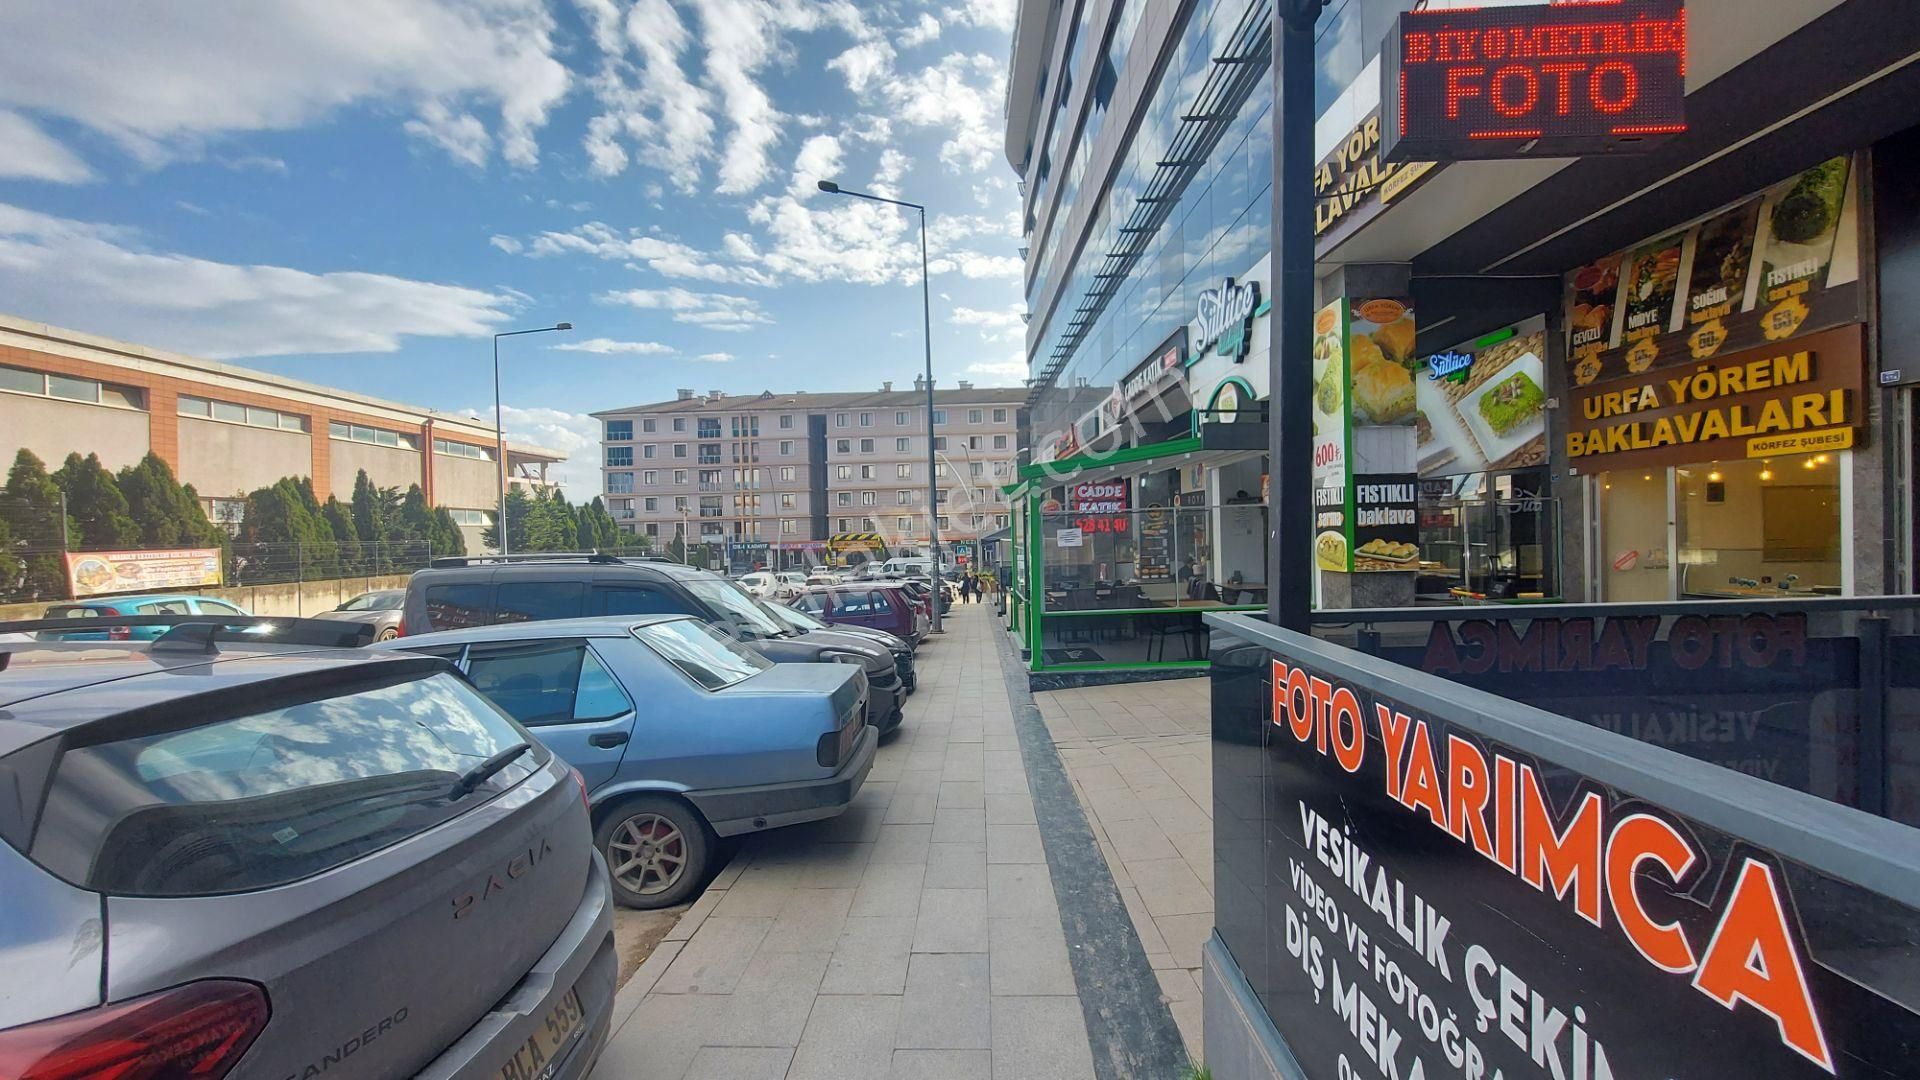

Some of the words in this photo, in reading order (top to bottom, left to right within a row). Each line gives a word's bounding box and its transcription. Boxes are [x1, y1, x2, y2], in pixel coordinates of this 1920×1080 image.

[1447, 60, 1638, 119] FOTO
[1315, 155, 1397, 235] LAVAL
[1766, 257, 1819, 287] FISTIKLI
[1196, 276, 1255, 352] Sütlüce
[1692, 287, 1728, 310] SOĞUK
[1429, 351, 1472, 381] Sütlüce
[1583, 384, 1660, 420] URFA
[1668, 351, 1809, 404] YÖREM
[1566, 388, 1845, 457] BAKLAVALARI
[1752, 437, 1797, 452] KÖRFEZ
[1800, 431, 1846, 450] ŞUBESİ
[1077, 485, 1122, 498] CADDE
[1078, 501, 1122, 514] KATIK
[1316, 486, 1344, 507] FISTIKLI
[1356, 484, 1414, 504] FISTIKLI
[1357, 507, 1416, 526] baklava
[1272, 659, 1366, 773] FOTO
[1376, 702, 1837, 1076] YARIMCA
[1299, 800, 1452, 983] VESİKALIK
[1286, 904, 1325, 1005] DİŞ
[1289, 857, 1339, 933] VİDEO
[1343, 911, 1369, 971] VE
[1375, 944, 1504, 1080] FOTOĞR
